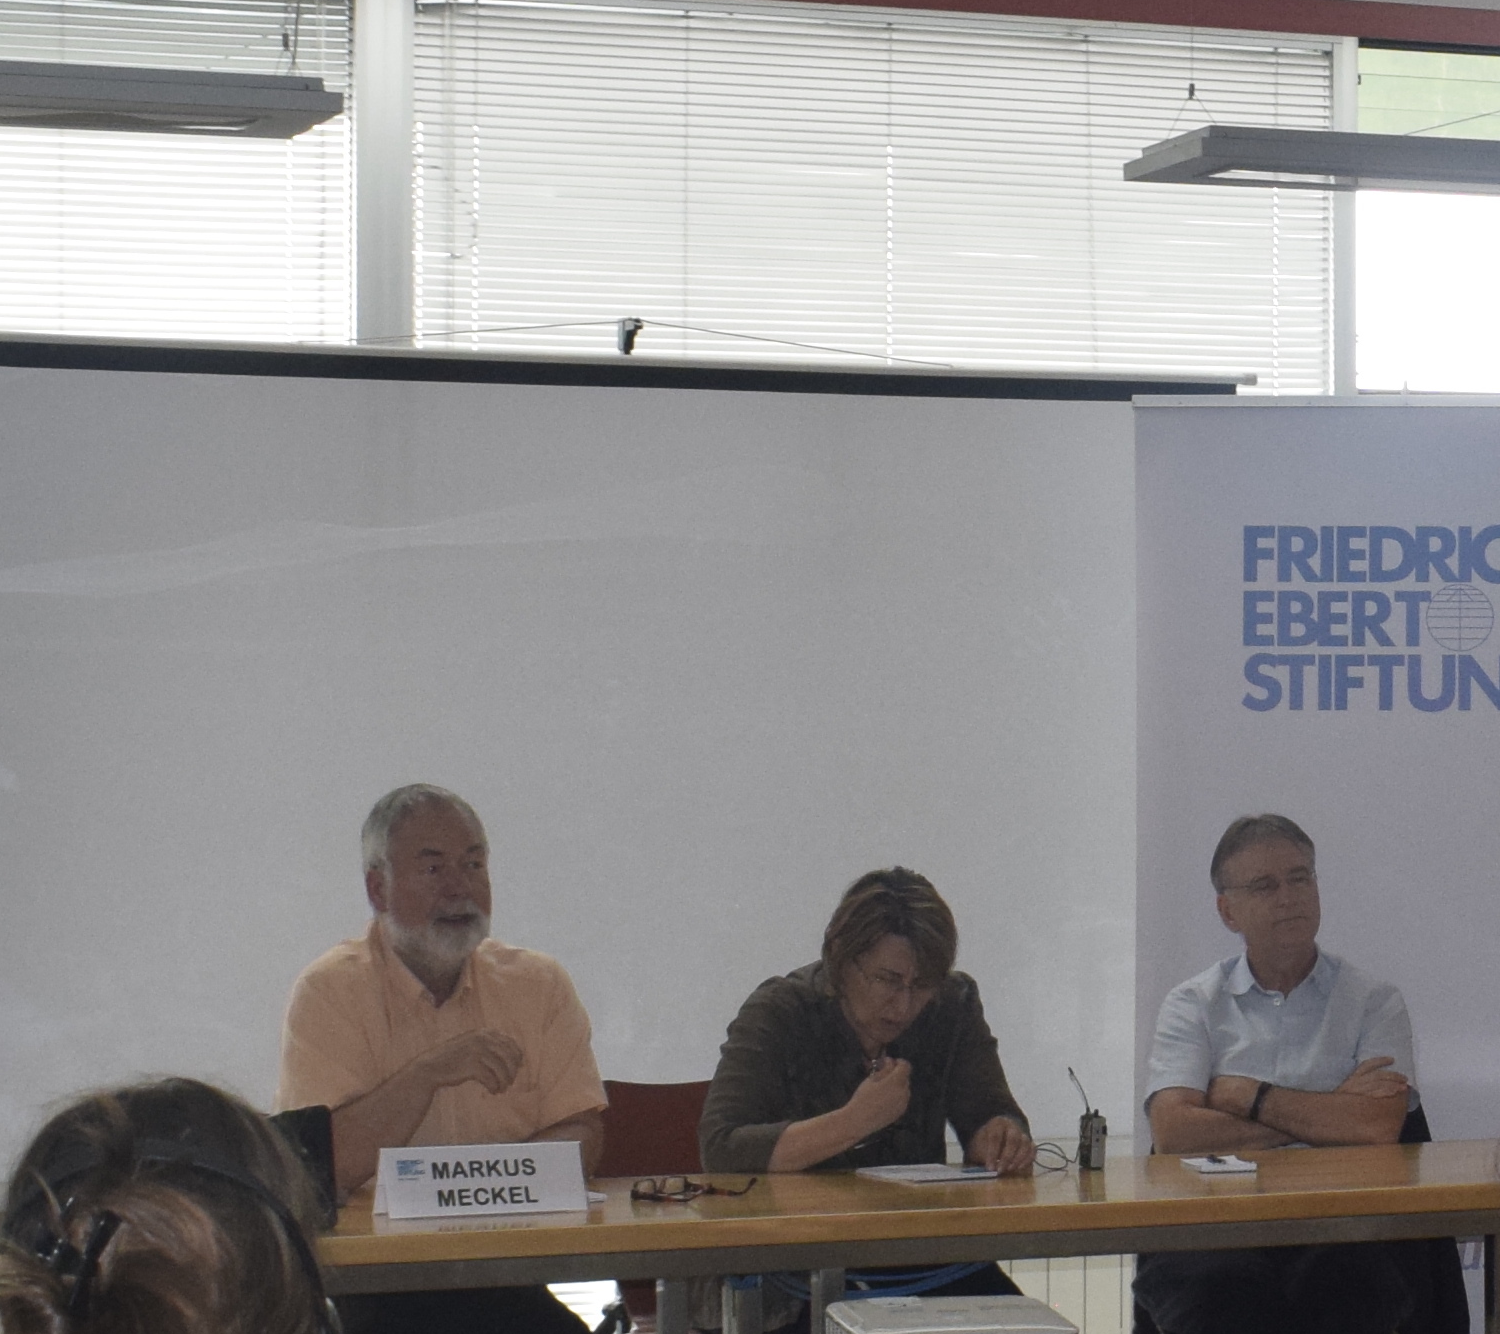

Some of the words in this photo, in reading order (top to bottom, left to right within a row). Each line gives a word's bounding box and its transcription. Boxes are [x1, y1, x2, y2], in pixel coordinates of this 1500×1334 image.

[1242, 590, 1432, 647] EBERT
[431, 1158, 537, 1180] MARKUS
[437, 1185, 539, 1207] MECKEL
